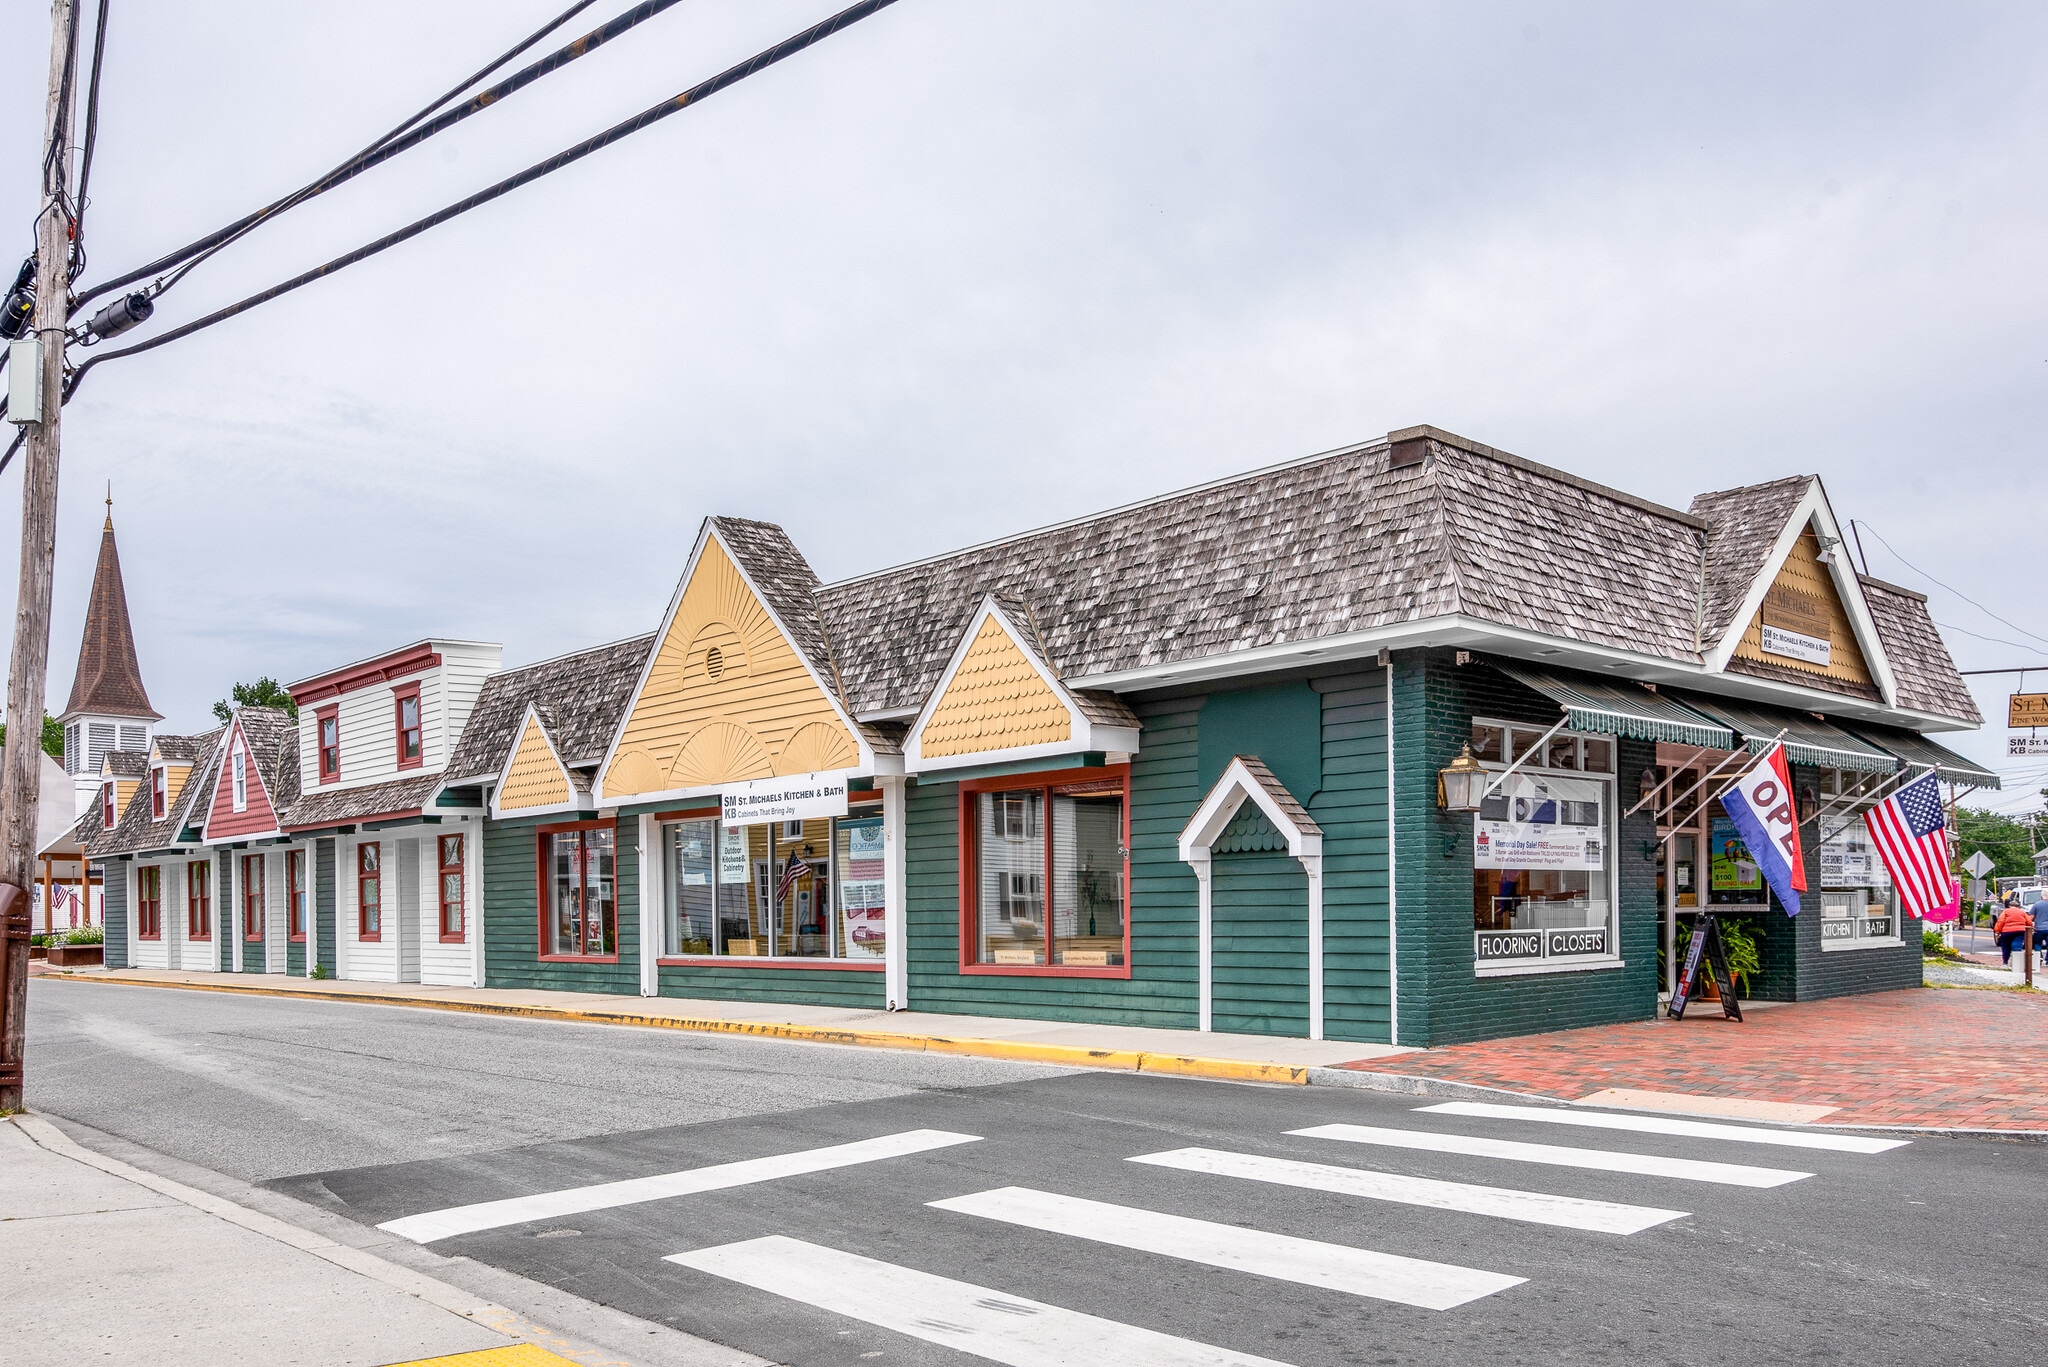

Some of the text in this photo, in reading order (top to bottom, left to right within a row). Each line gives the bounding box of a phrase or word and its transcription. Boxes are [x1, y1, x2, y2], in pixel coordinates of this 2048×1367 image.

[1778, 591, 1815, 616] MICHAELS
[1764, 629, 1771, 638] SM
[1780, 634, 1798, 645] MICHAELS
[1799, 640, 1814, 649] KITCHEN
[1764, 639, 1771, 648] KB
[2013, 698, 2035, 711] ST.
[724, 796, 736, 806] SM
[749, 794, 782, 804] MICHAELS
[784, 790, 814, 800] KITCHEN
[824, 787, 844, 796] BATH
[724, 808, 736, 819] KB
[771, 808, 784, 816] Bring
[1495, 840, 1516, 848] Memorial
[1517, 841, 1525, 850] Day
[1823, 922, 1884, 936] KITCHEN BATH
[1482, 934, 1602, 955] FLOORING CLOSETS
